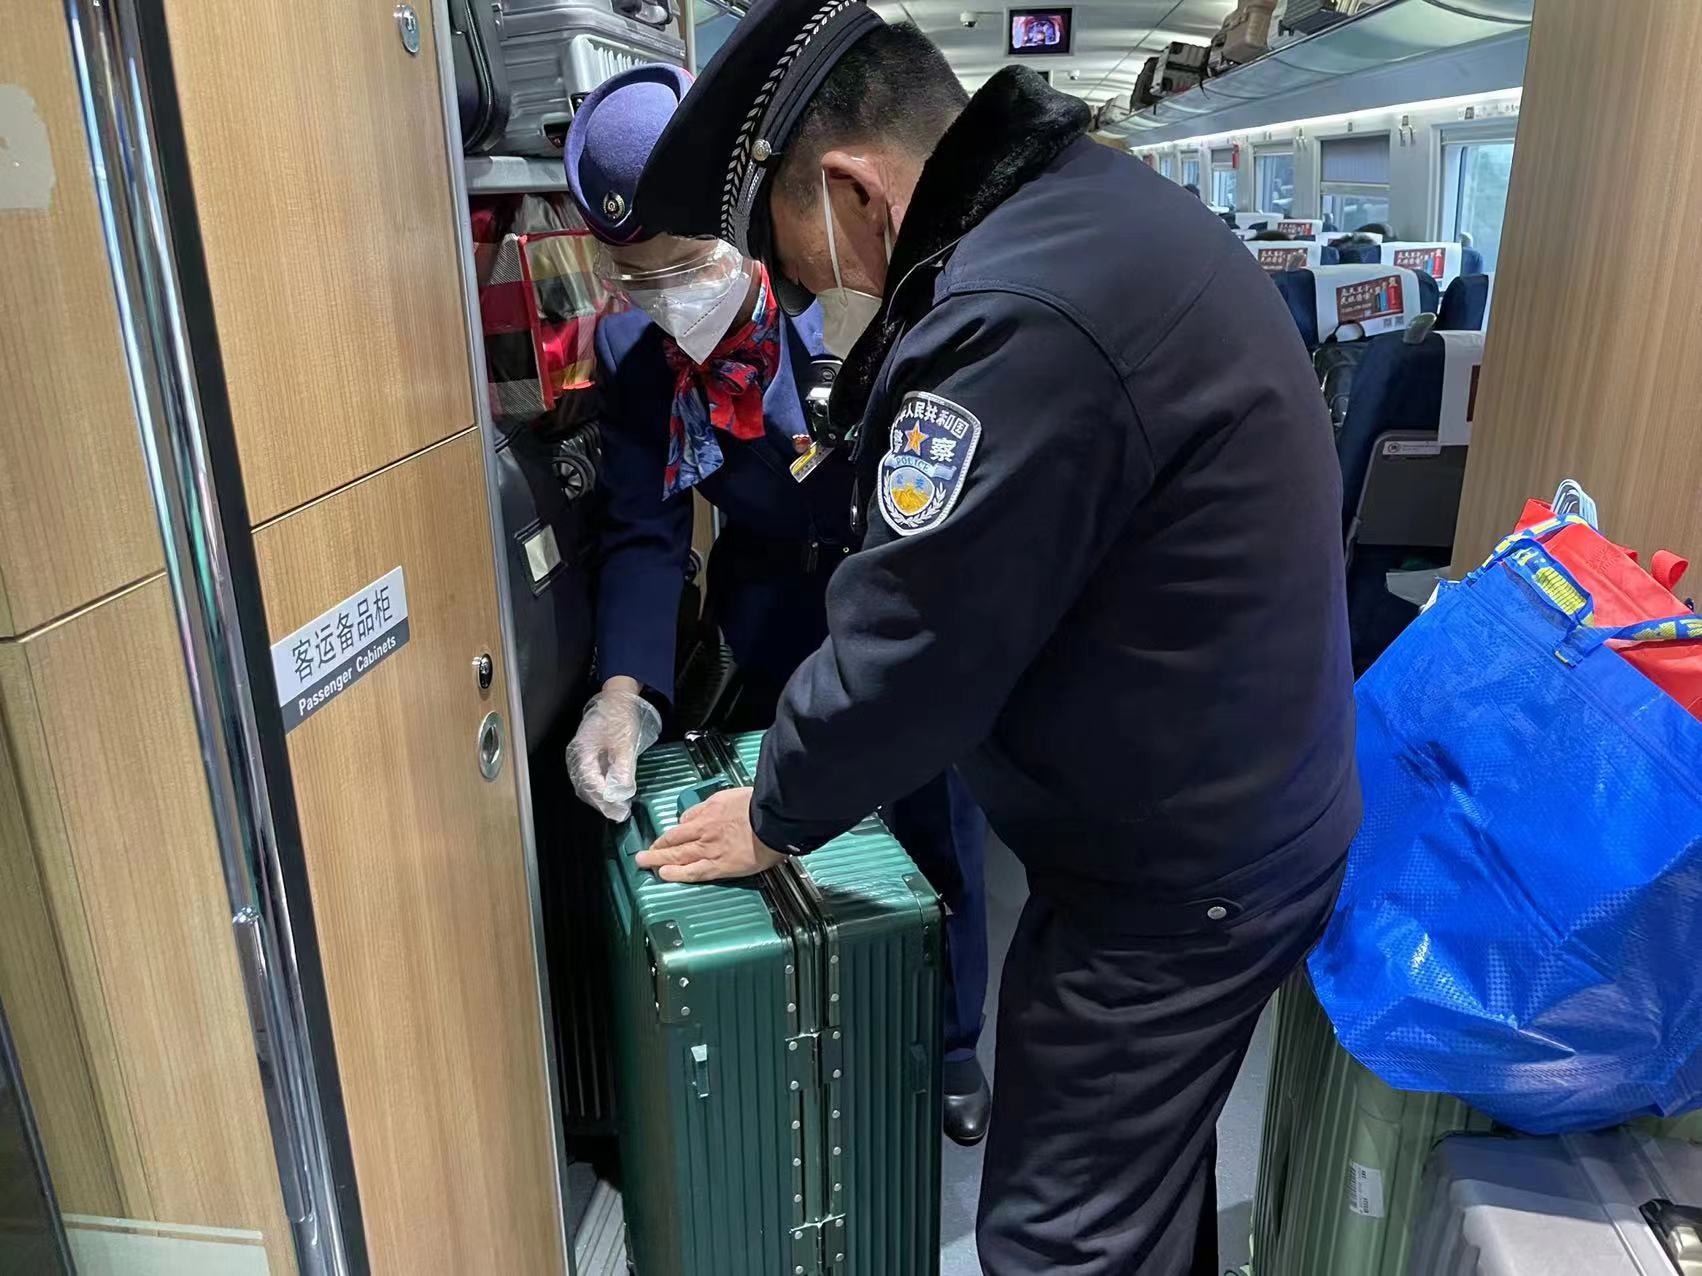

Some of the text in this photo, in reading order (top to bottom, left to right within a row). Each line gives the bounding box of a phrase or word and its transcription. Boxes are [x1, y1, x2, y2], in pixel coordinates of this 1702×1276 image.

[895, 400, 969, 439] 人民共和国
[896, 457, 931, 474] POLICE
[292, 585, 393, 683] 客运备品柜
[298, 635, 397, 716] Passenger Cabinets
